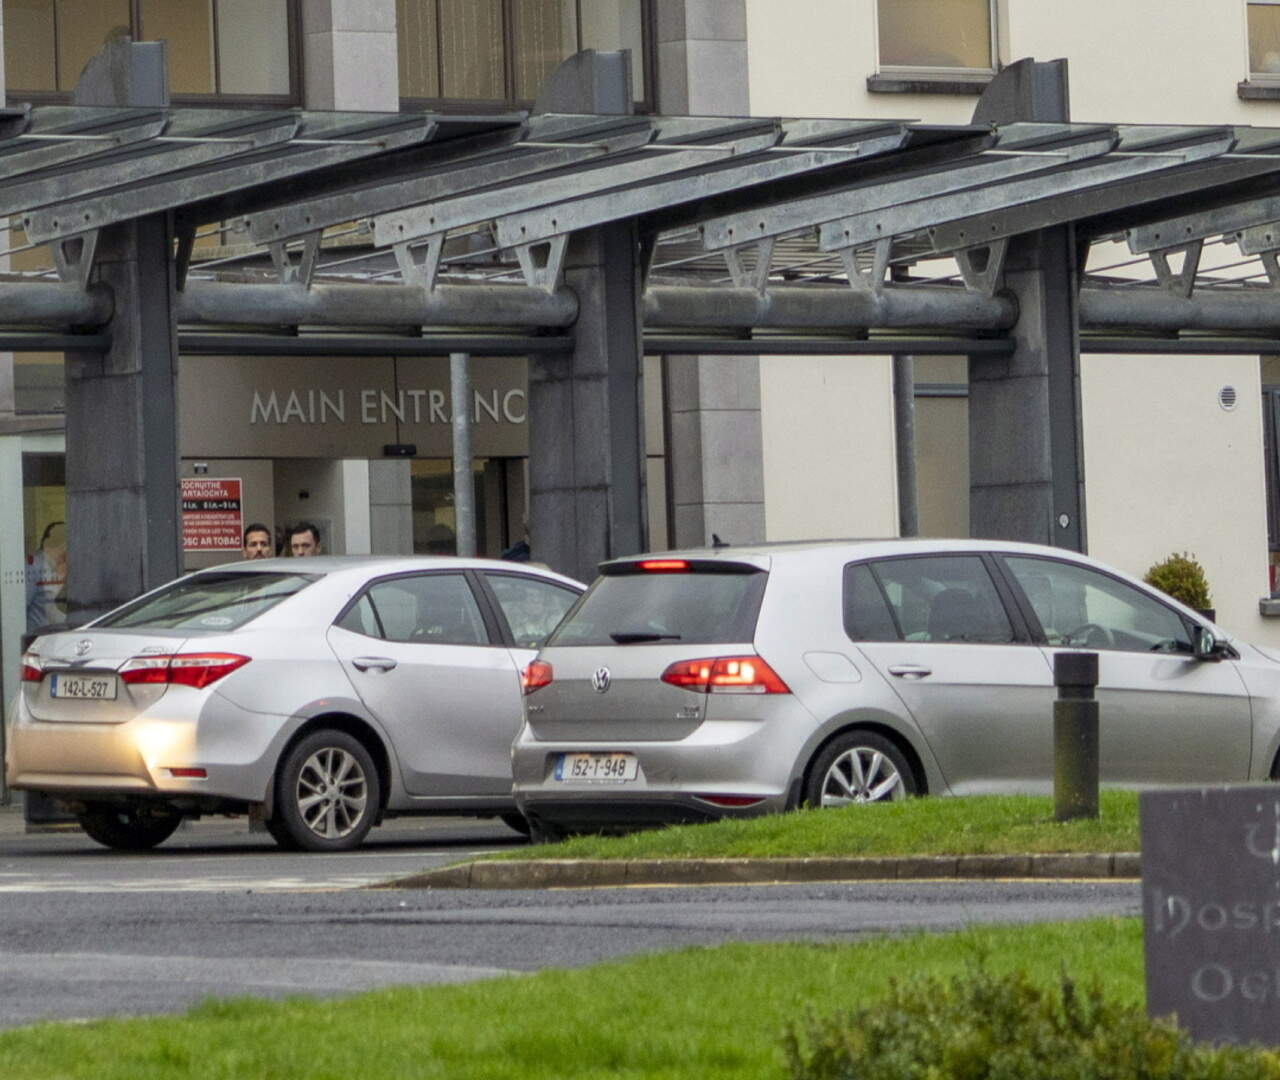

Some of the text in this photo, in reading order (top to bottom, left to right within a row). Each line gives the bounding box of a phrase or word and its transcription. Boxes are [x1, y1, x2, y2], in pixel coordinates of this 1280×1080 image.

[250, 389, 525, 424] MAIN ENTRNC
[63, 681, 108, 697] 142-L-527
[571, 759, 626, 777] 152-T-948
